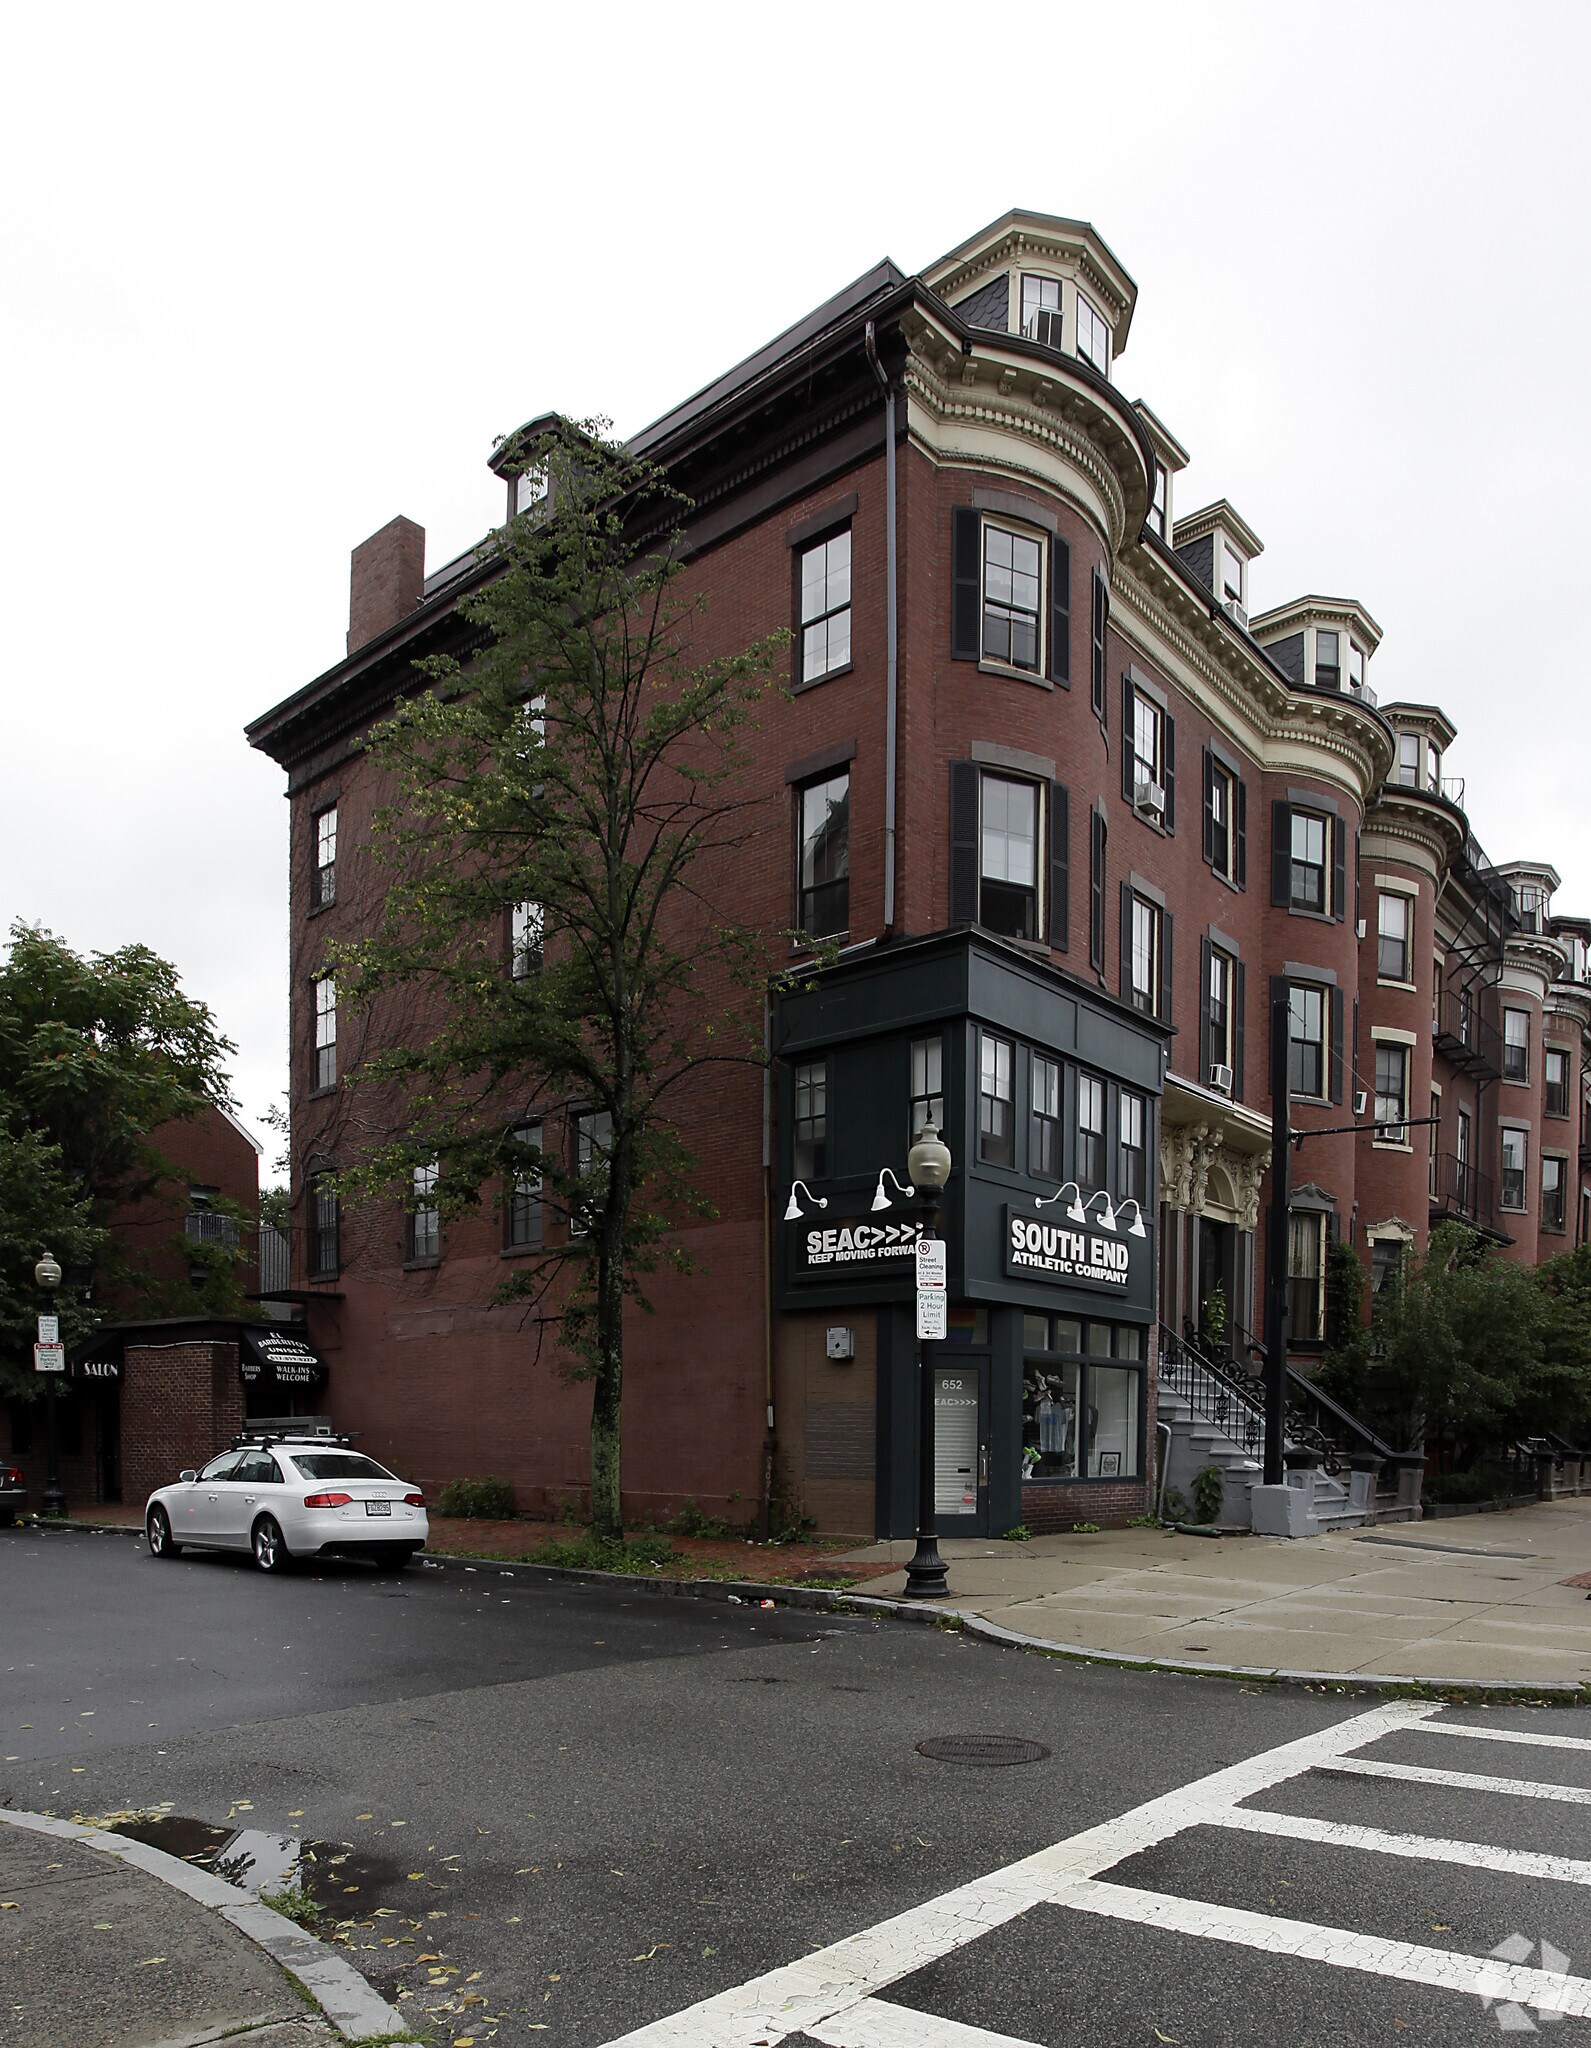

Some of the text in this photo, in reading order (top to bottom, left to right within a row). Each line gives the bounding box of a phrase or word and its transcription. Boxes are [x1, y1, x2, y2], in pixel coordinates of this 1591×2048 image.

[1011, 1219, 1129, 1271] SOUTH END
[808, 1244, 916, 1264] KEEP MOVING FORWA
[919, 1263, 944, 1271] Cleaning
[1011, 1251, 1128, 1284] ATHLETIC COMPANY
[919, 1293, 945, 1302] Parking
[84, 1362, 118, 1376] SALON
[276, 1365, 310, 1374] WALK-INS
[276, 1373, 310, 1382] WELCOME
[942, 1379, 963, 1390] 652
[935, 1398, 954, 1406] EAC
